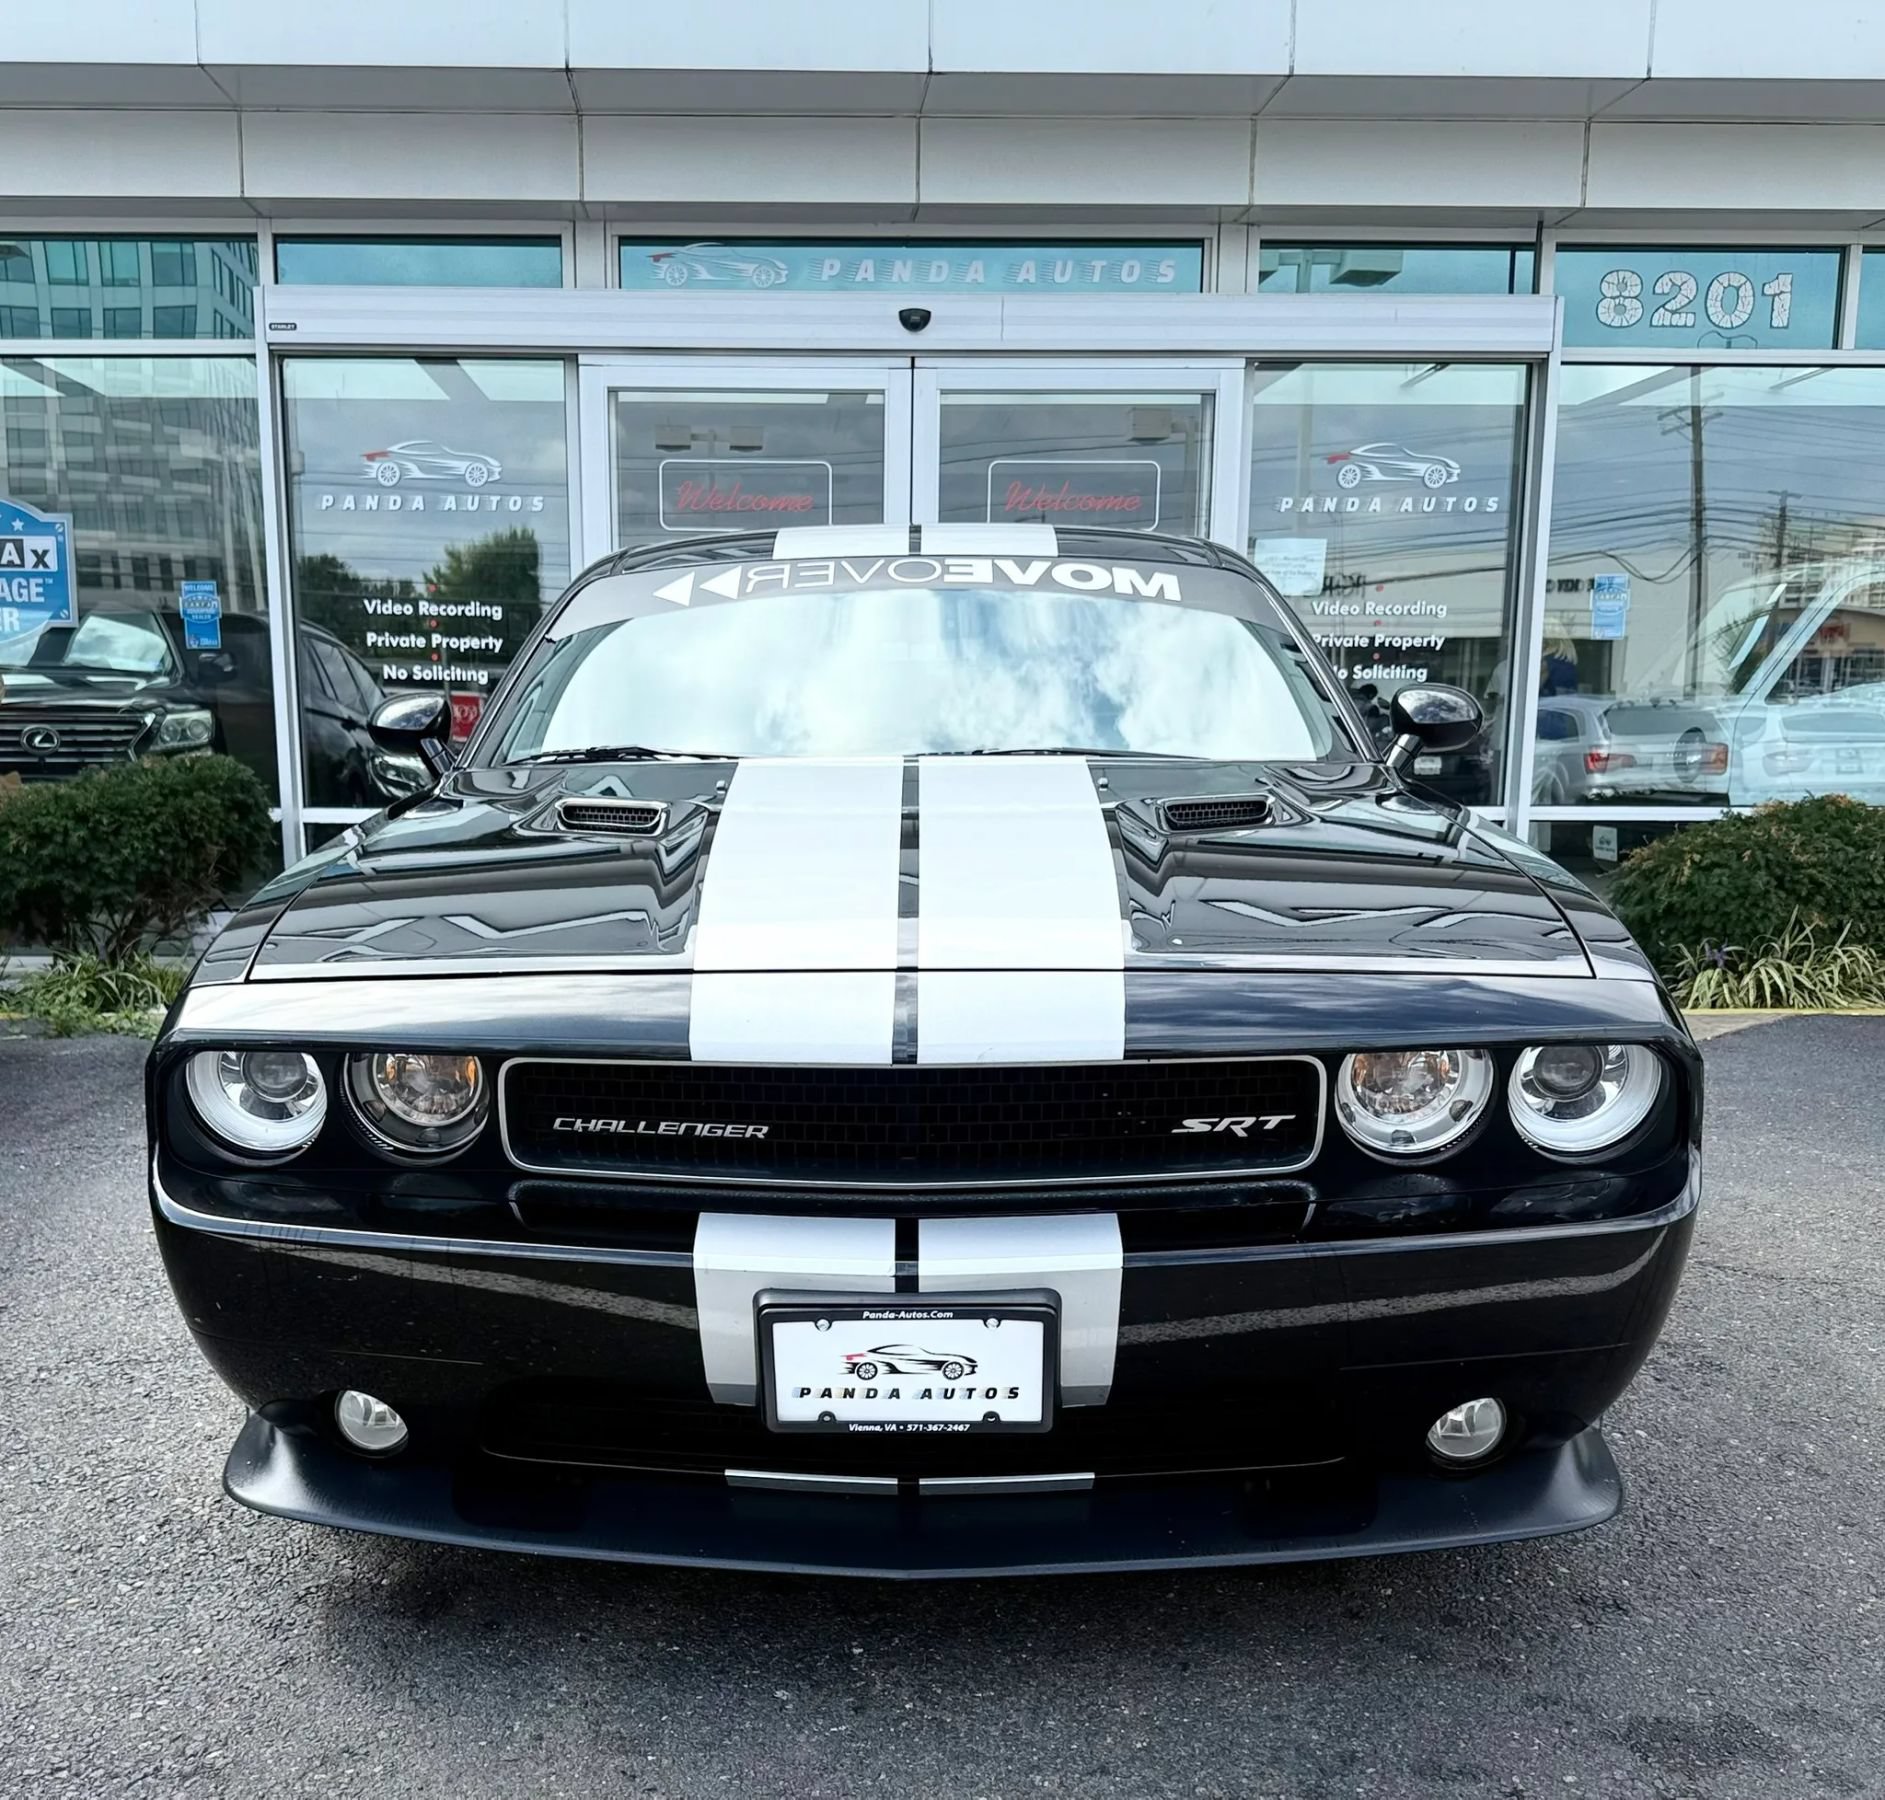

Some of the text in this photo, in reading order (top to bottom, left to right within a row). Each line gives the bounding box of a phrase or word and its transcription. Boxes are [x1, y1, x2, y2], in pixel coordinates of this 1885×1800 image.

[820, 258, 1177, 284] PANDA AUTOS
[1596, 269, 1794, 329] 8201
[321, 495, 545, 512] PANDA AUTOS
[676, 480, 815, 513] Welcome
[1004, 480, 1141, 513] Welcome
[1278, 496, 1499, 513] PANDA AUTOS
[0, 607, 21, 632] R
[364, 599, 503, 621] Video Recording
[1311, 600, 1448, 619] Video Recording
[366, 632, 504, 653] Private Property
[1374, 633, 1446, 651] Property
[383, 664, 489, 685] No Soliciting
[1333, 664, 1429, 683] o Soliciting
[552, 1117, 770, 1139] CHALLENGER
[1171, 1114, 1297, 1137] SRT
[862, 1310, 954, 1319] Panda-Autos.Com
[798, 1387, 1020, 1400] PANDA AUTOS
[848, 1423, 971, 1433] Vienna, VA 571-367-2467
